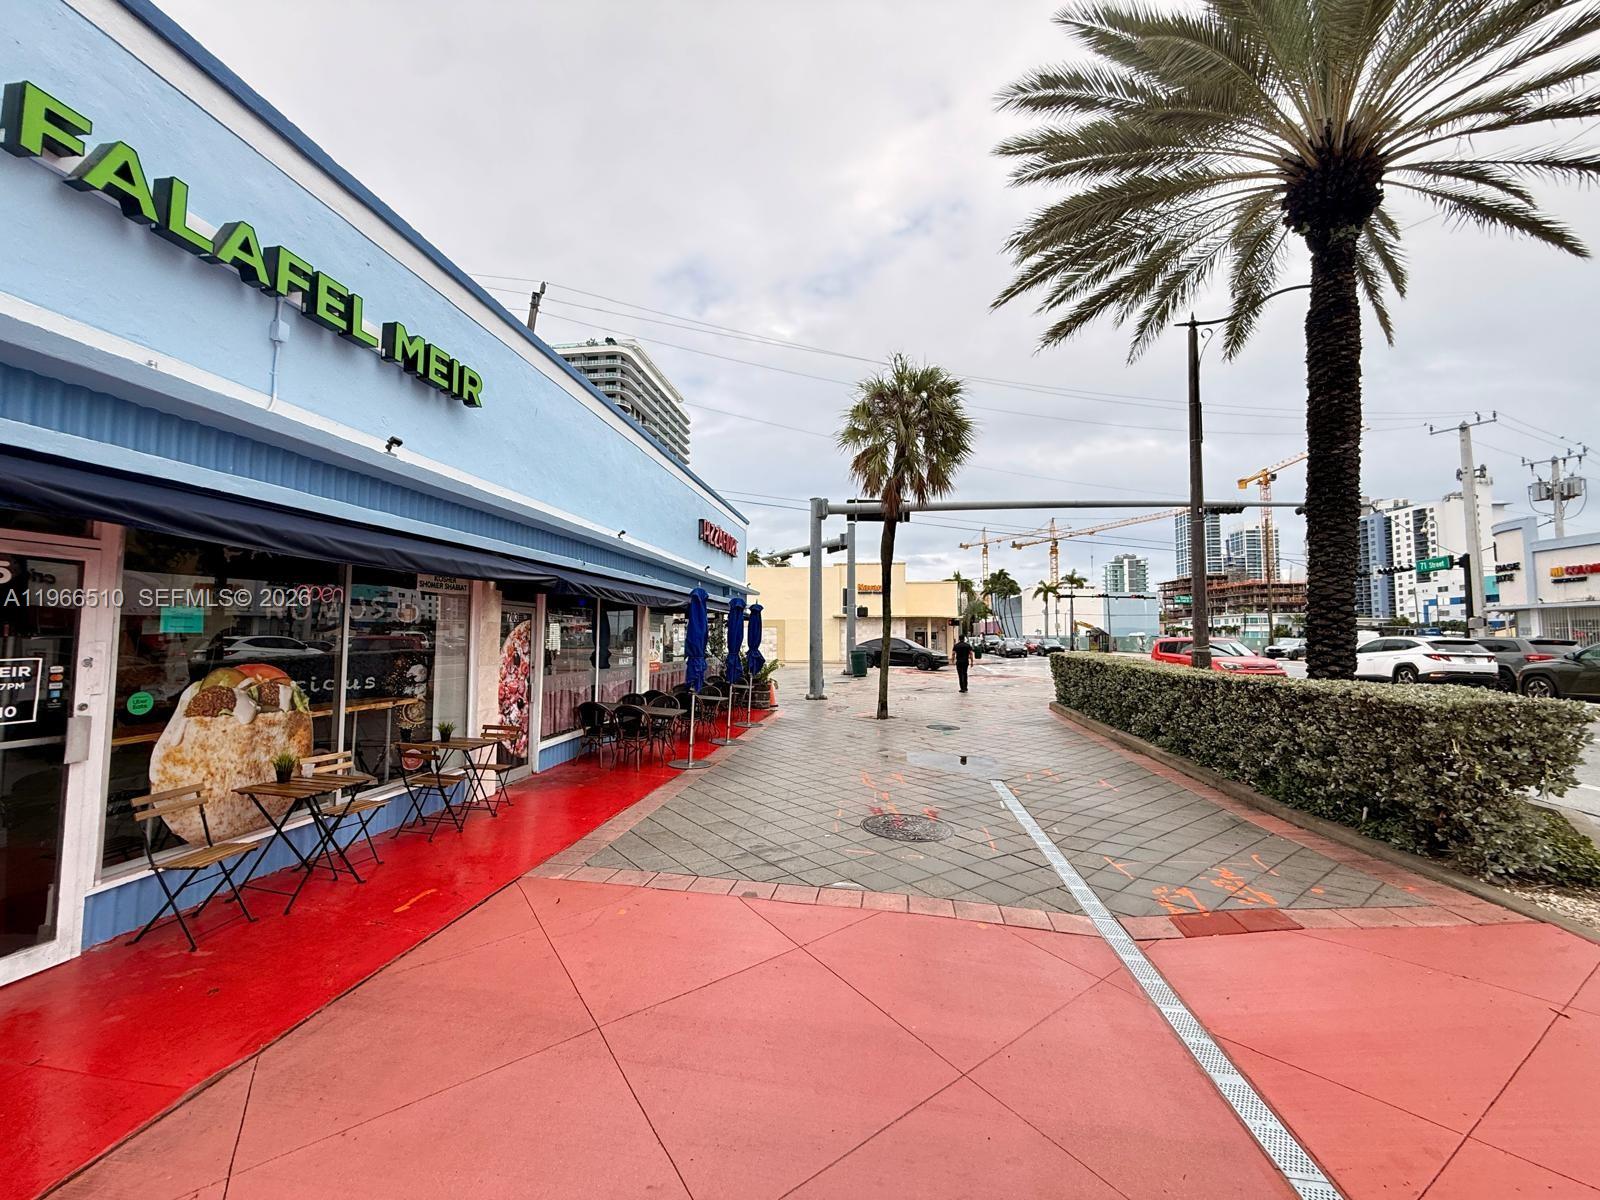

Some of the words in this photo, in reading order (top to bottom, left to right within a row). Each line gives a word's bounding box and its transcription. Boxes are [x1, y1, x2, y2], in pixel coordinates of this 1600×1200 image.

[1, 80, 378, 349] FALAFEL
[381, 321, 483, 407] MEIR
[419, 580, 444, 590] SHOMER
